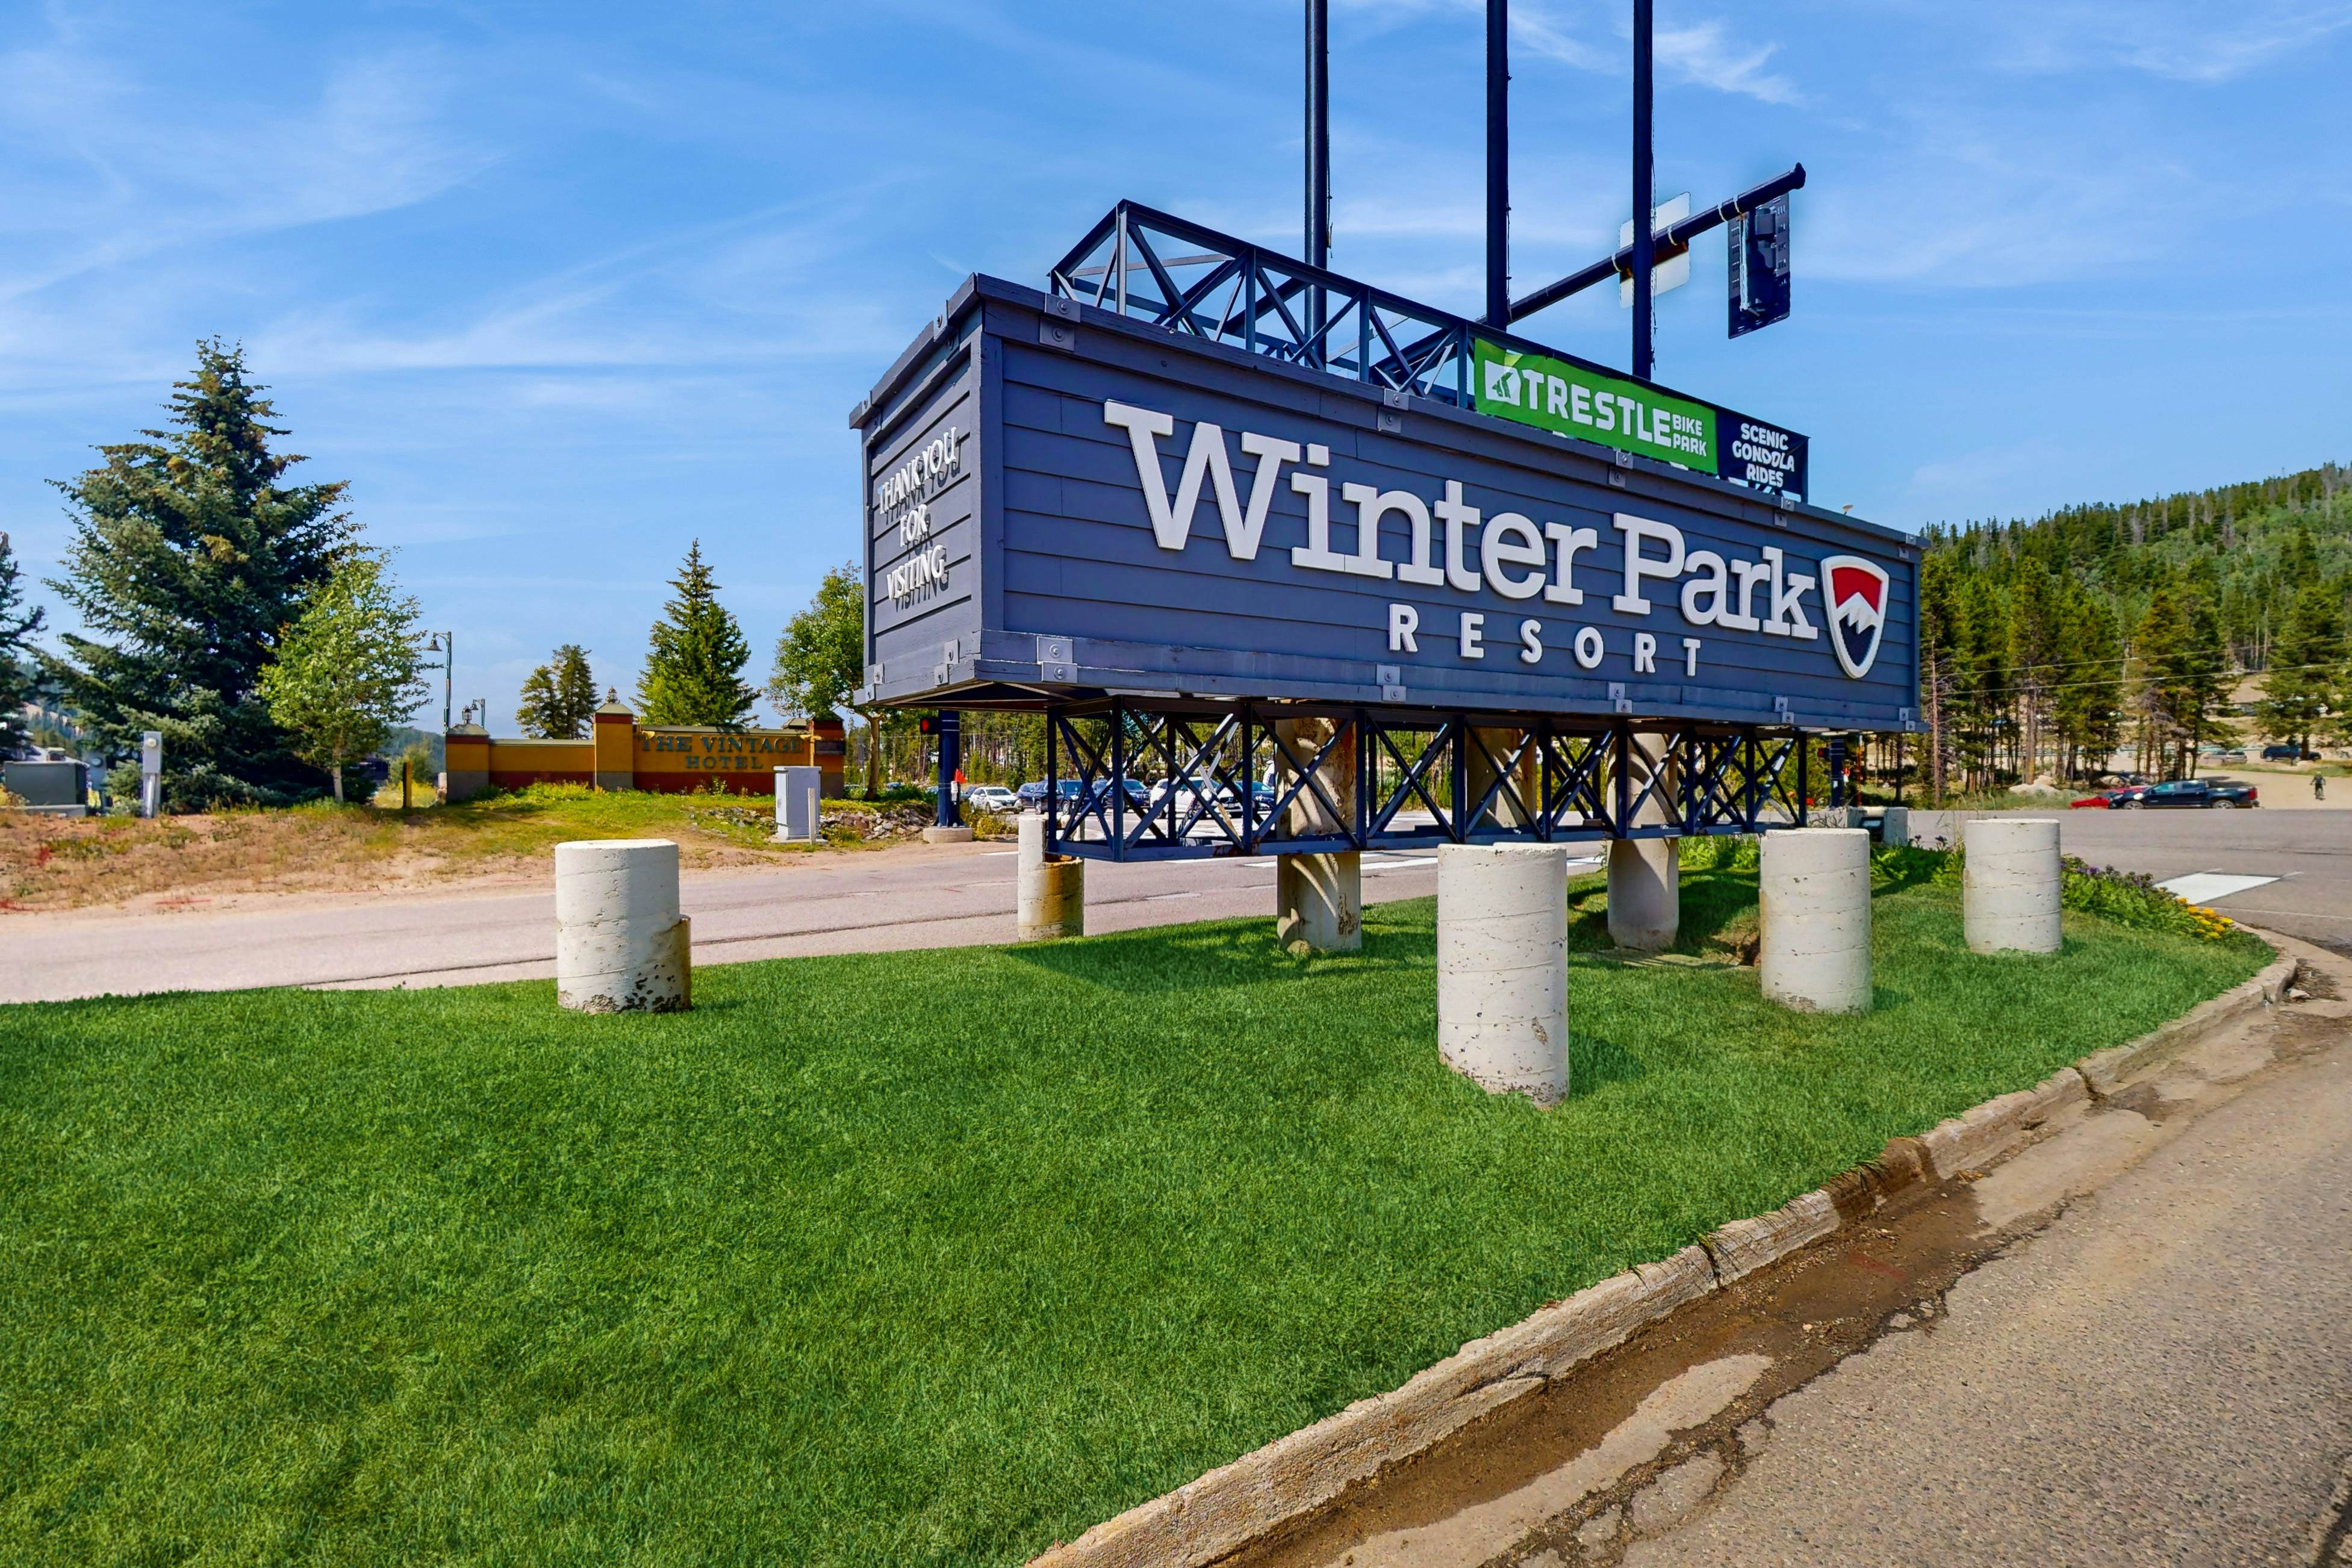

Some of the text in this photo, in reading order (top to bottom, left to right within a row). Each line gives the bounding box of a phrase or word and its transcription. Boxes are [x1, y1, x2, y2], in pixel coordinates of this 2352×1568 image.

[1522, 369, 1672, 447] TRESTLE
[1672, 414, 1703, 437] BIKE
[1741, 423, 1789, 451] SCENIC
[1672, 434, 1707, 458] PARK
[1732, 441, 1794, 472] GONDOLA
[877, 426, 958, 515] THANK YOU
[1746, 463, 1784, 488] RIDES
[900, 503, 928, 548] FOR
[1104, 399, 1818, 640] Winter Park
[886, 544, 946, 601] VISITING
[1388, 603, 1701, 677] RESORT
[641, 735, 804, 753] THE VINTAGE
[685, 755, 764, 770] HOTEL
